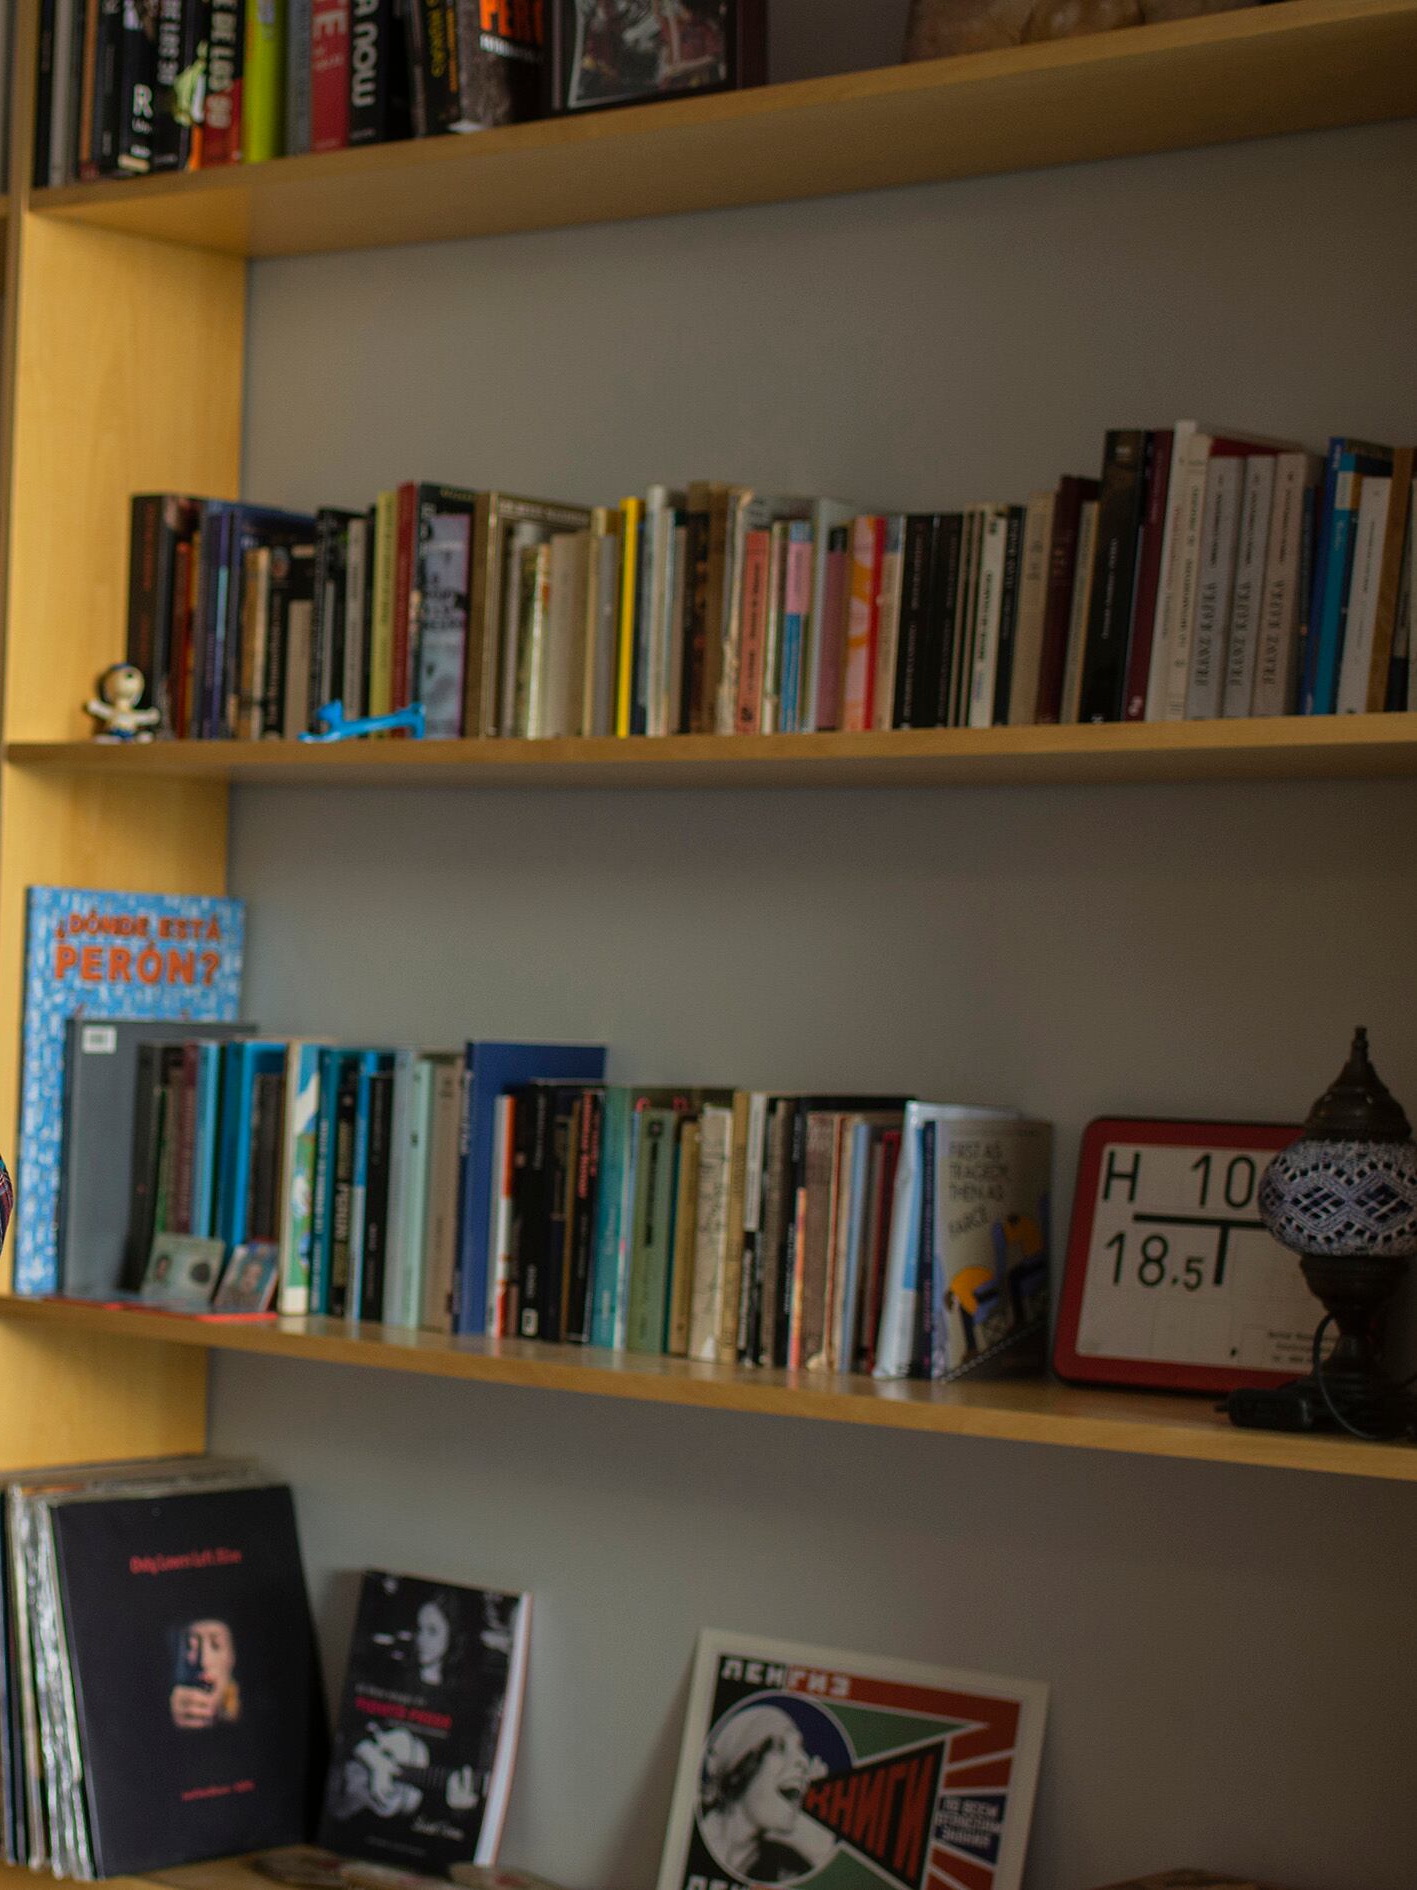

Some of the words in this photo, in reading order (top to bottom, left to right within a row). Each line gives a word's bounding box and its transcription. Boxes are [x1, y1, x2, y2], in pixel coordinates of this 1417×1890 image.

[1199, 581, 1218, 633] KAFKA
[1233, 580, 1252, 632] KAFKA
[1267, 579, 1286, 630] KAFKA
[54, 908, 149, 939] ¿DÓNDE
[158, 913, 221, 940] ESTÁ
[54, 941, 220, 986] PERÓN?
[1102, 1150, 1141, 1202] H
[721, 1659, 851, 1697] ЛЕНГИЗ
[805, 1753, 935, 1880] КНИГИ
